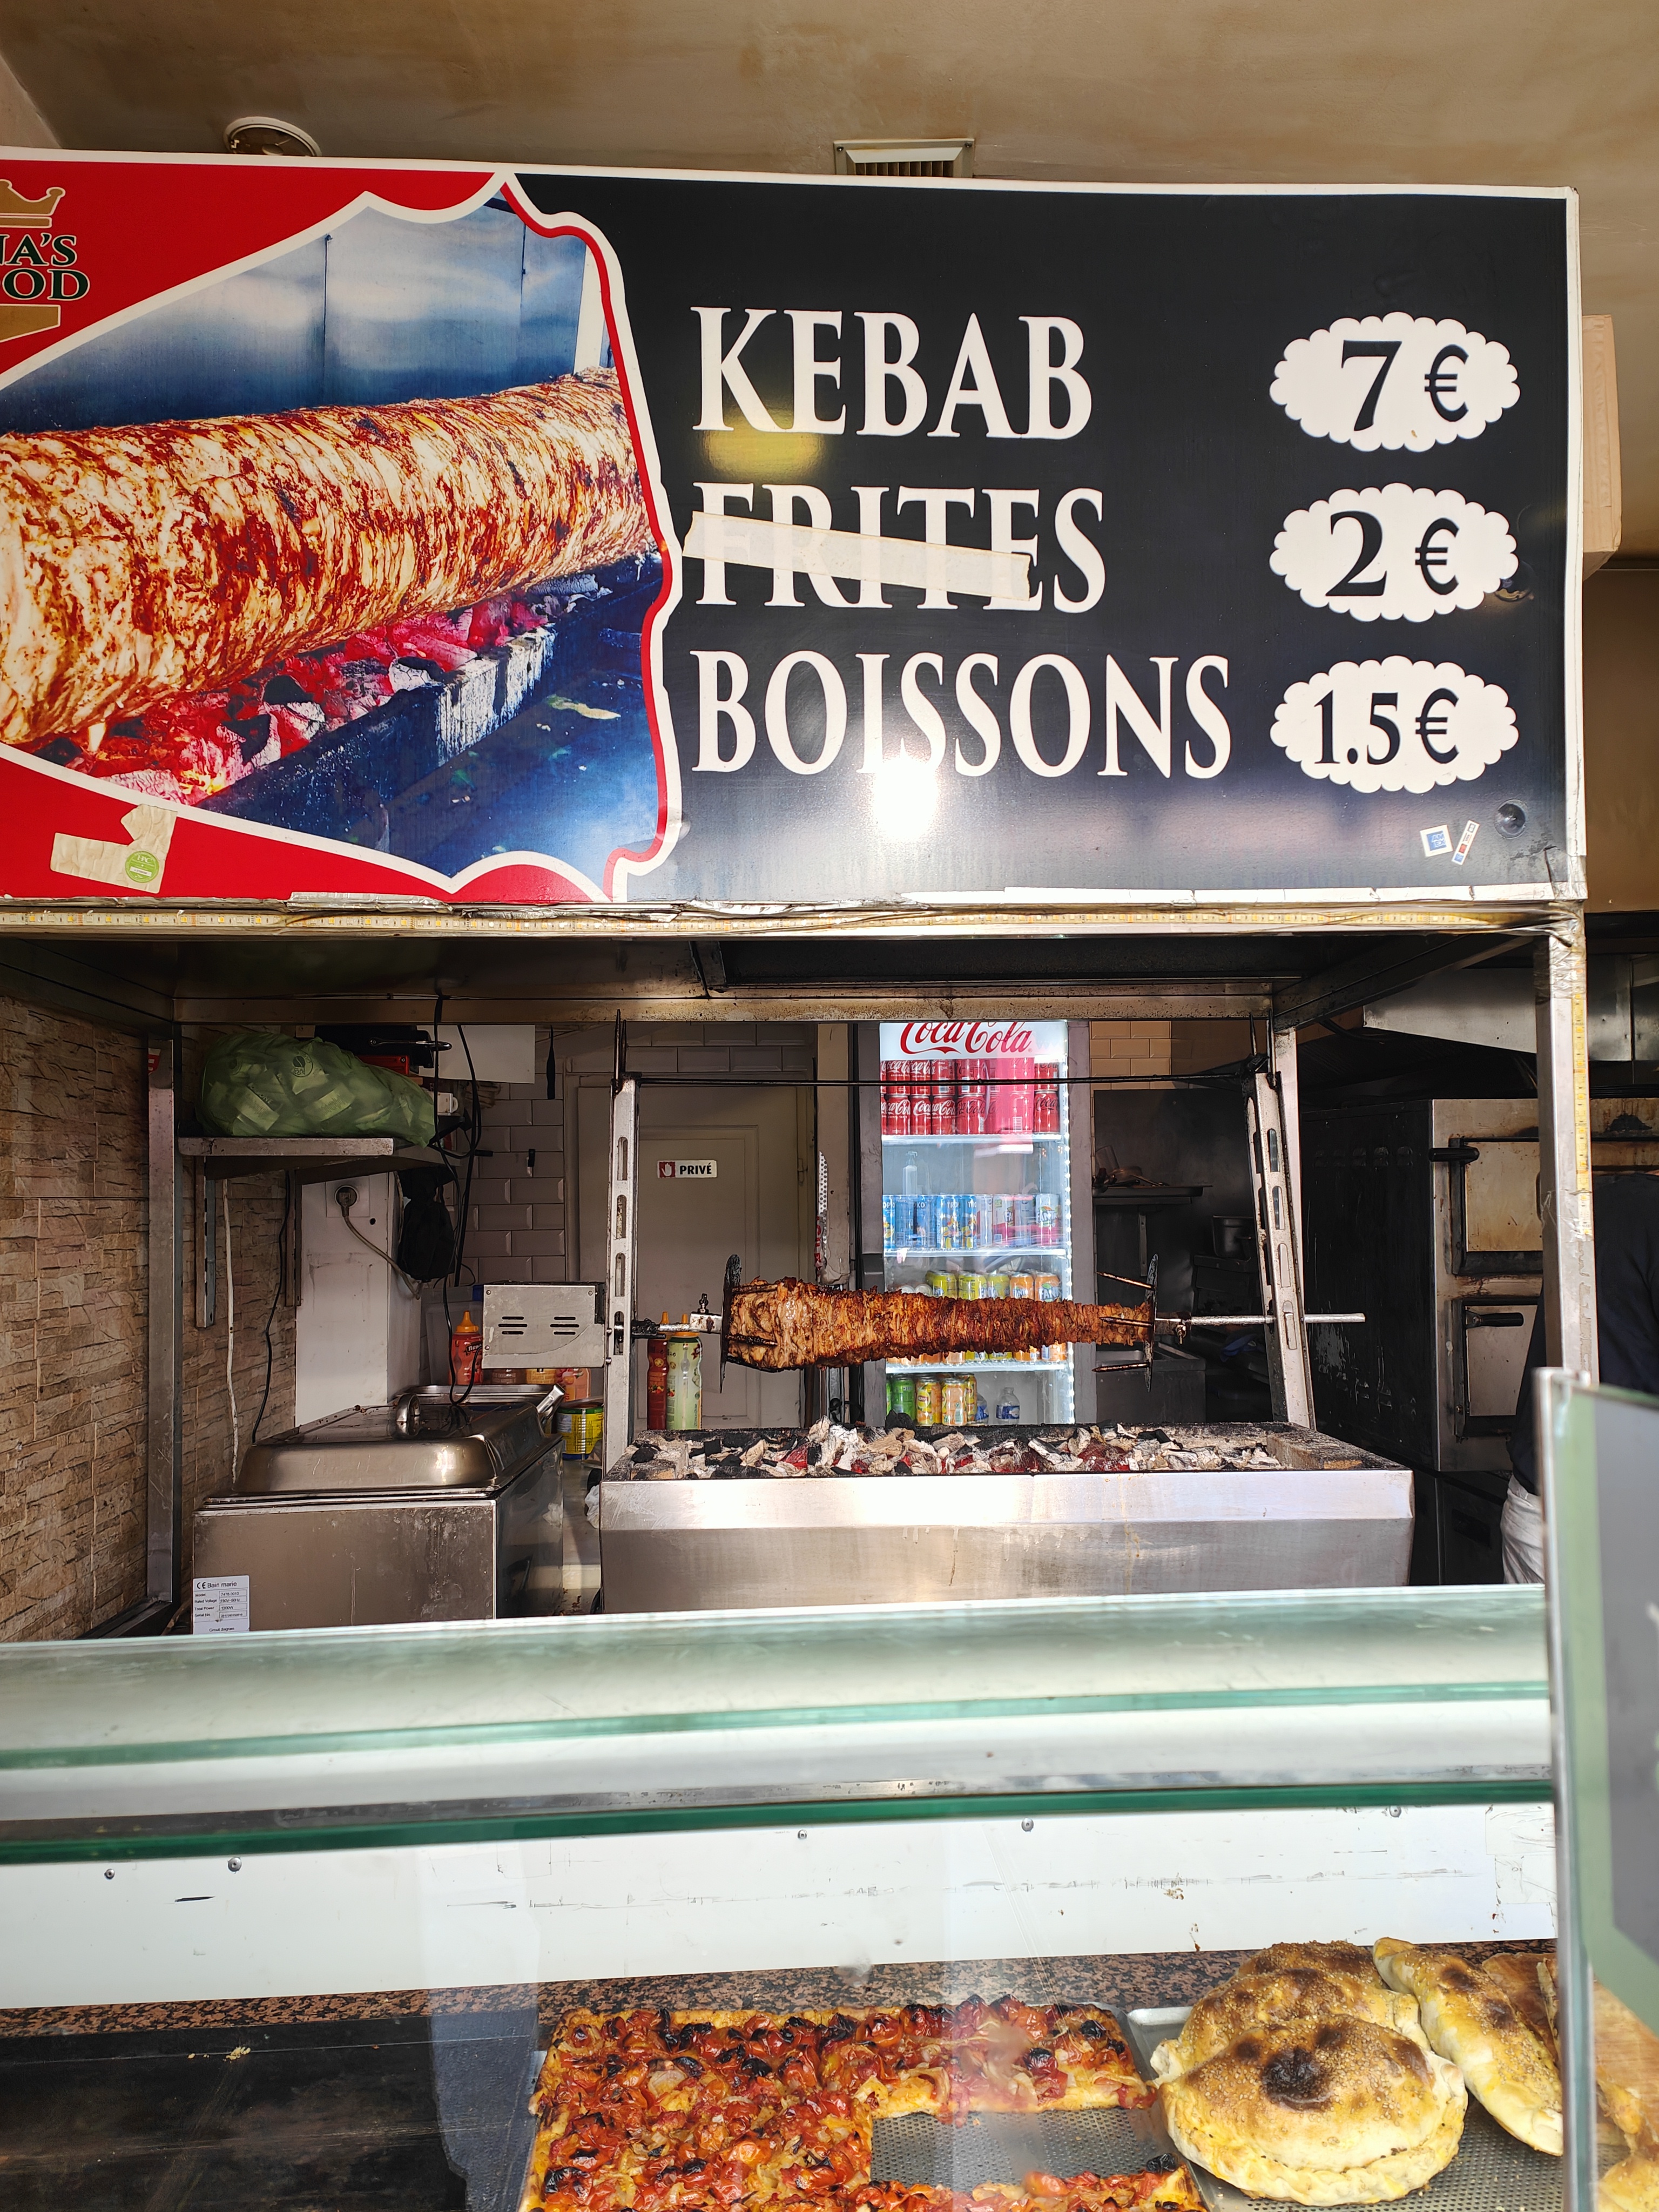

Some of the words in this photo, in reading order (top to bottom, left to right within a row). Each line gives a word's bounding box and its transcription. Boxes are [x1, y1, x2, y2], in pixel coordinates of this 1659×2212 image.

[0, 232, 78, 267] A'S
[0, 268, 90, 301] OD
[690, 306, 1093, 439] KEBAB
[1341, 340, 1402, 431] 7
[1424, 344, 1469, 422] €
[692, 482, 1106, 614] FRITES
[1325, 510, 1388, 597] 2
[1415, 517, 1460, 596] €
[689, 650, 1231, 779] BOISSONS
[679, 1162, 712, 1175] PRIVÉ
